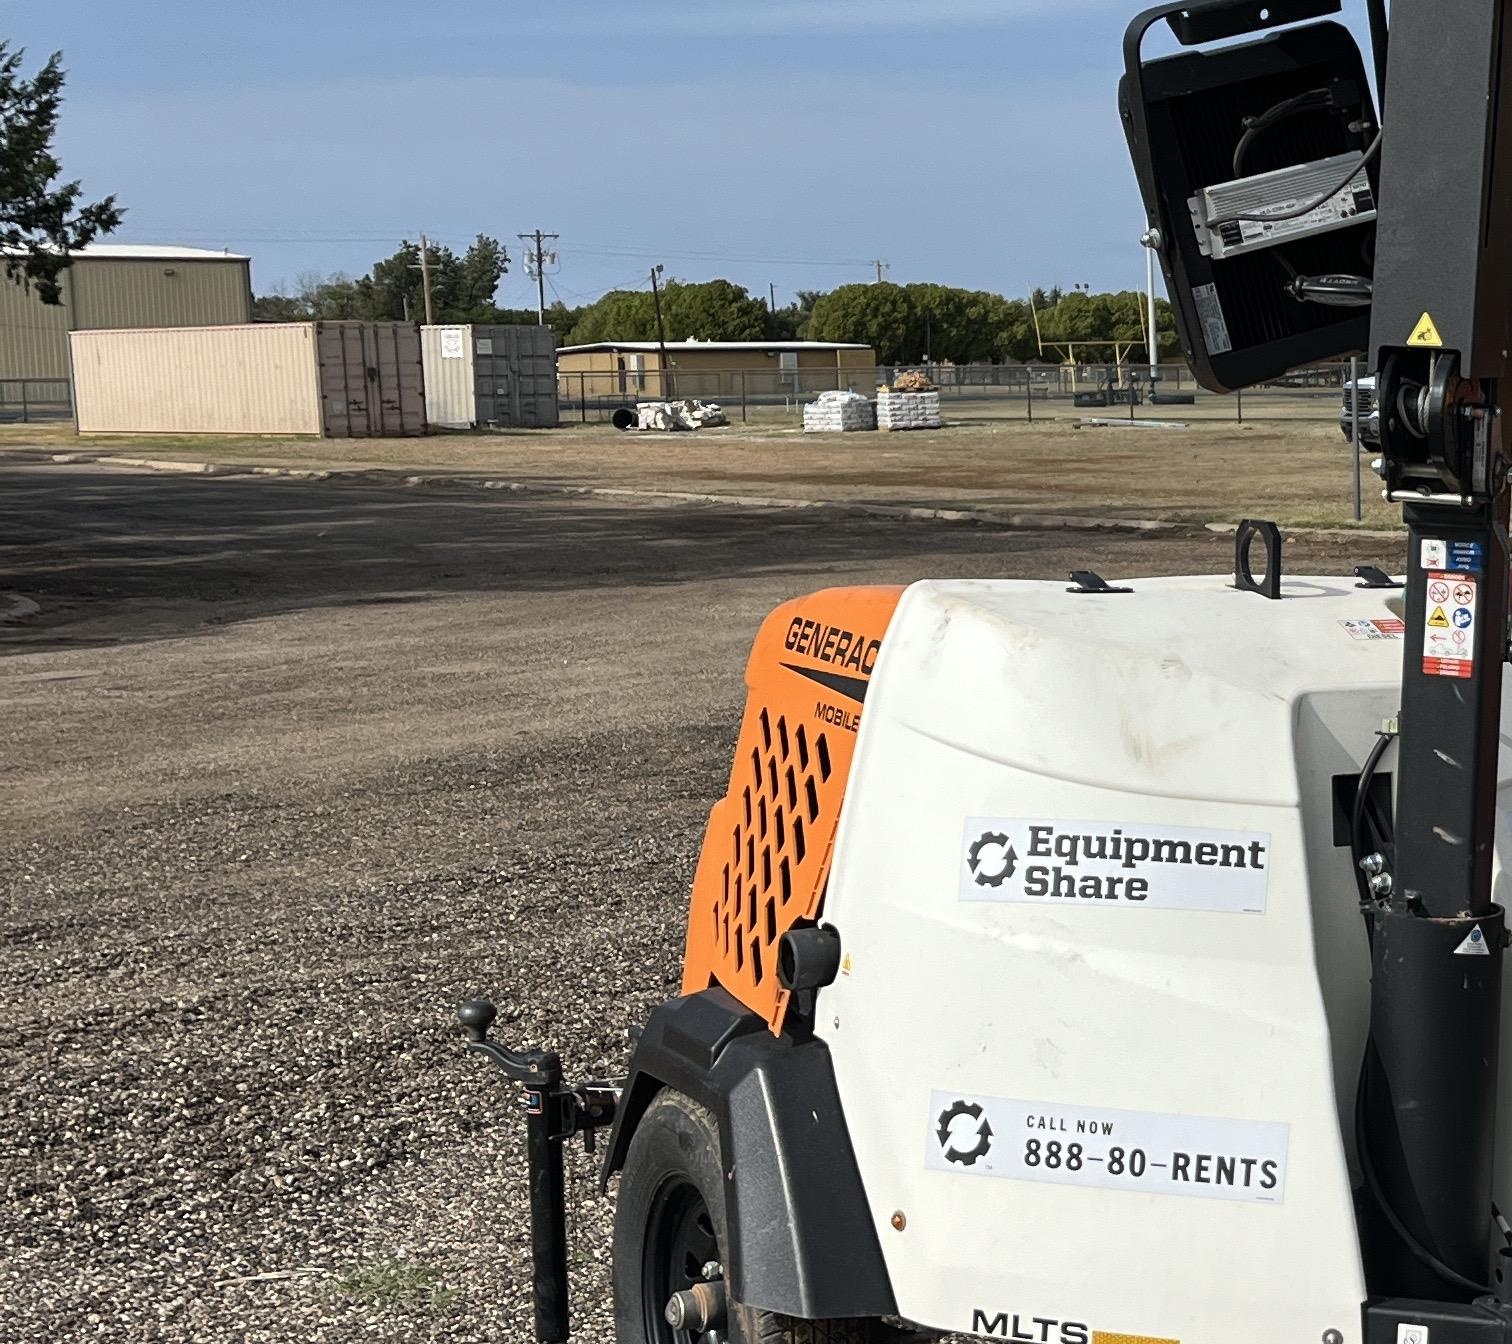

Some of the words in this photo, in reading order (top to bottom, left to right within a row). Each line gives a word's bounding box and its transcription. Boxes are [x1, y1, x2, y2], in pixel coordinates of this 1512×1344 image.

[784, 616, 882, 676] GENERAC
[814, 701, 861, 733] MOBILE
[1026, 825, 1266, 869] Equipment
[1023, 865, 1150, 901] Share
[1026, 1115, 1067, 1132] CALL
[1076, 1119, 1114, 1136] NOW
[1023, 1138, 1278, 1190] 888-80-RENTS
